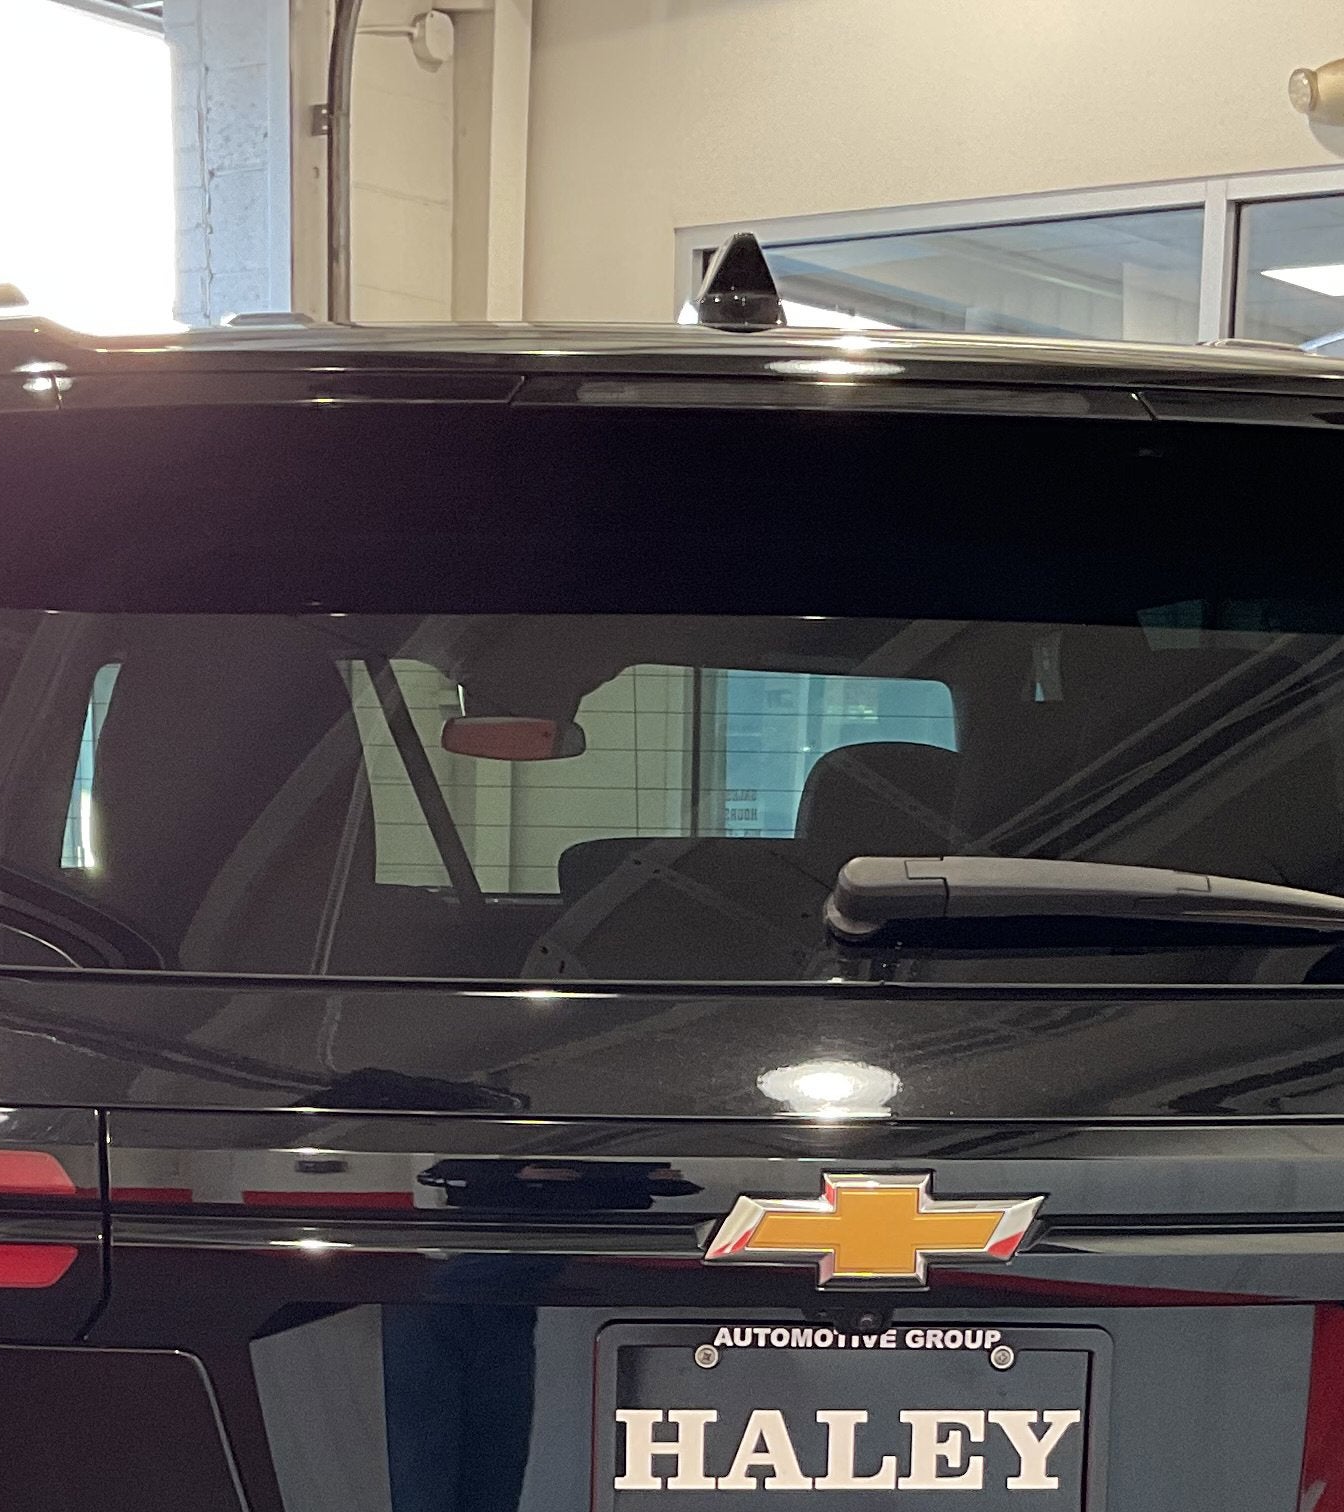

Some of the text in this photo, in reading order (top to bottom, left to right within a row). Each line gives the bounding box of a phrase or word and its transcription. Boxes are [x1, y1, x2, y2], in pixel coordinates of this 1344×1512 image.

[714, 1327, 1001, 1350] AUTOMOTIVE GROUP
[614, 1409, 1081, 1490] HALEY
